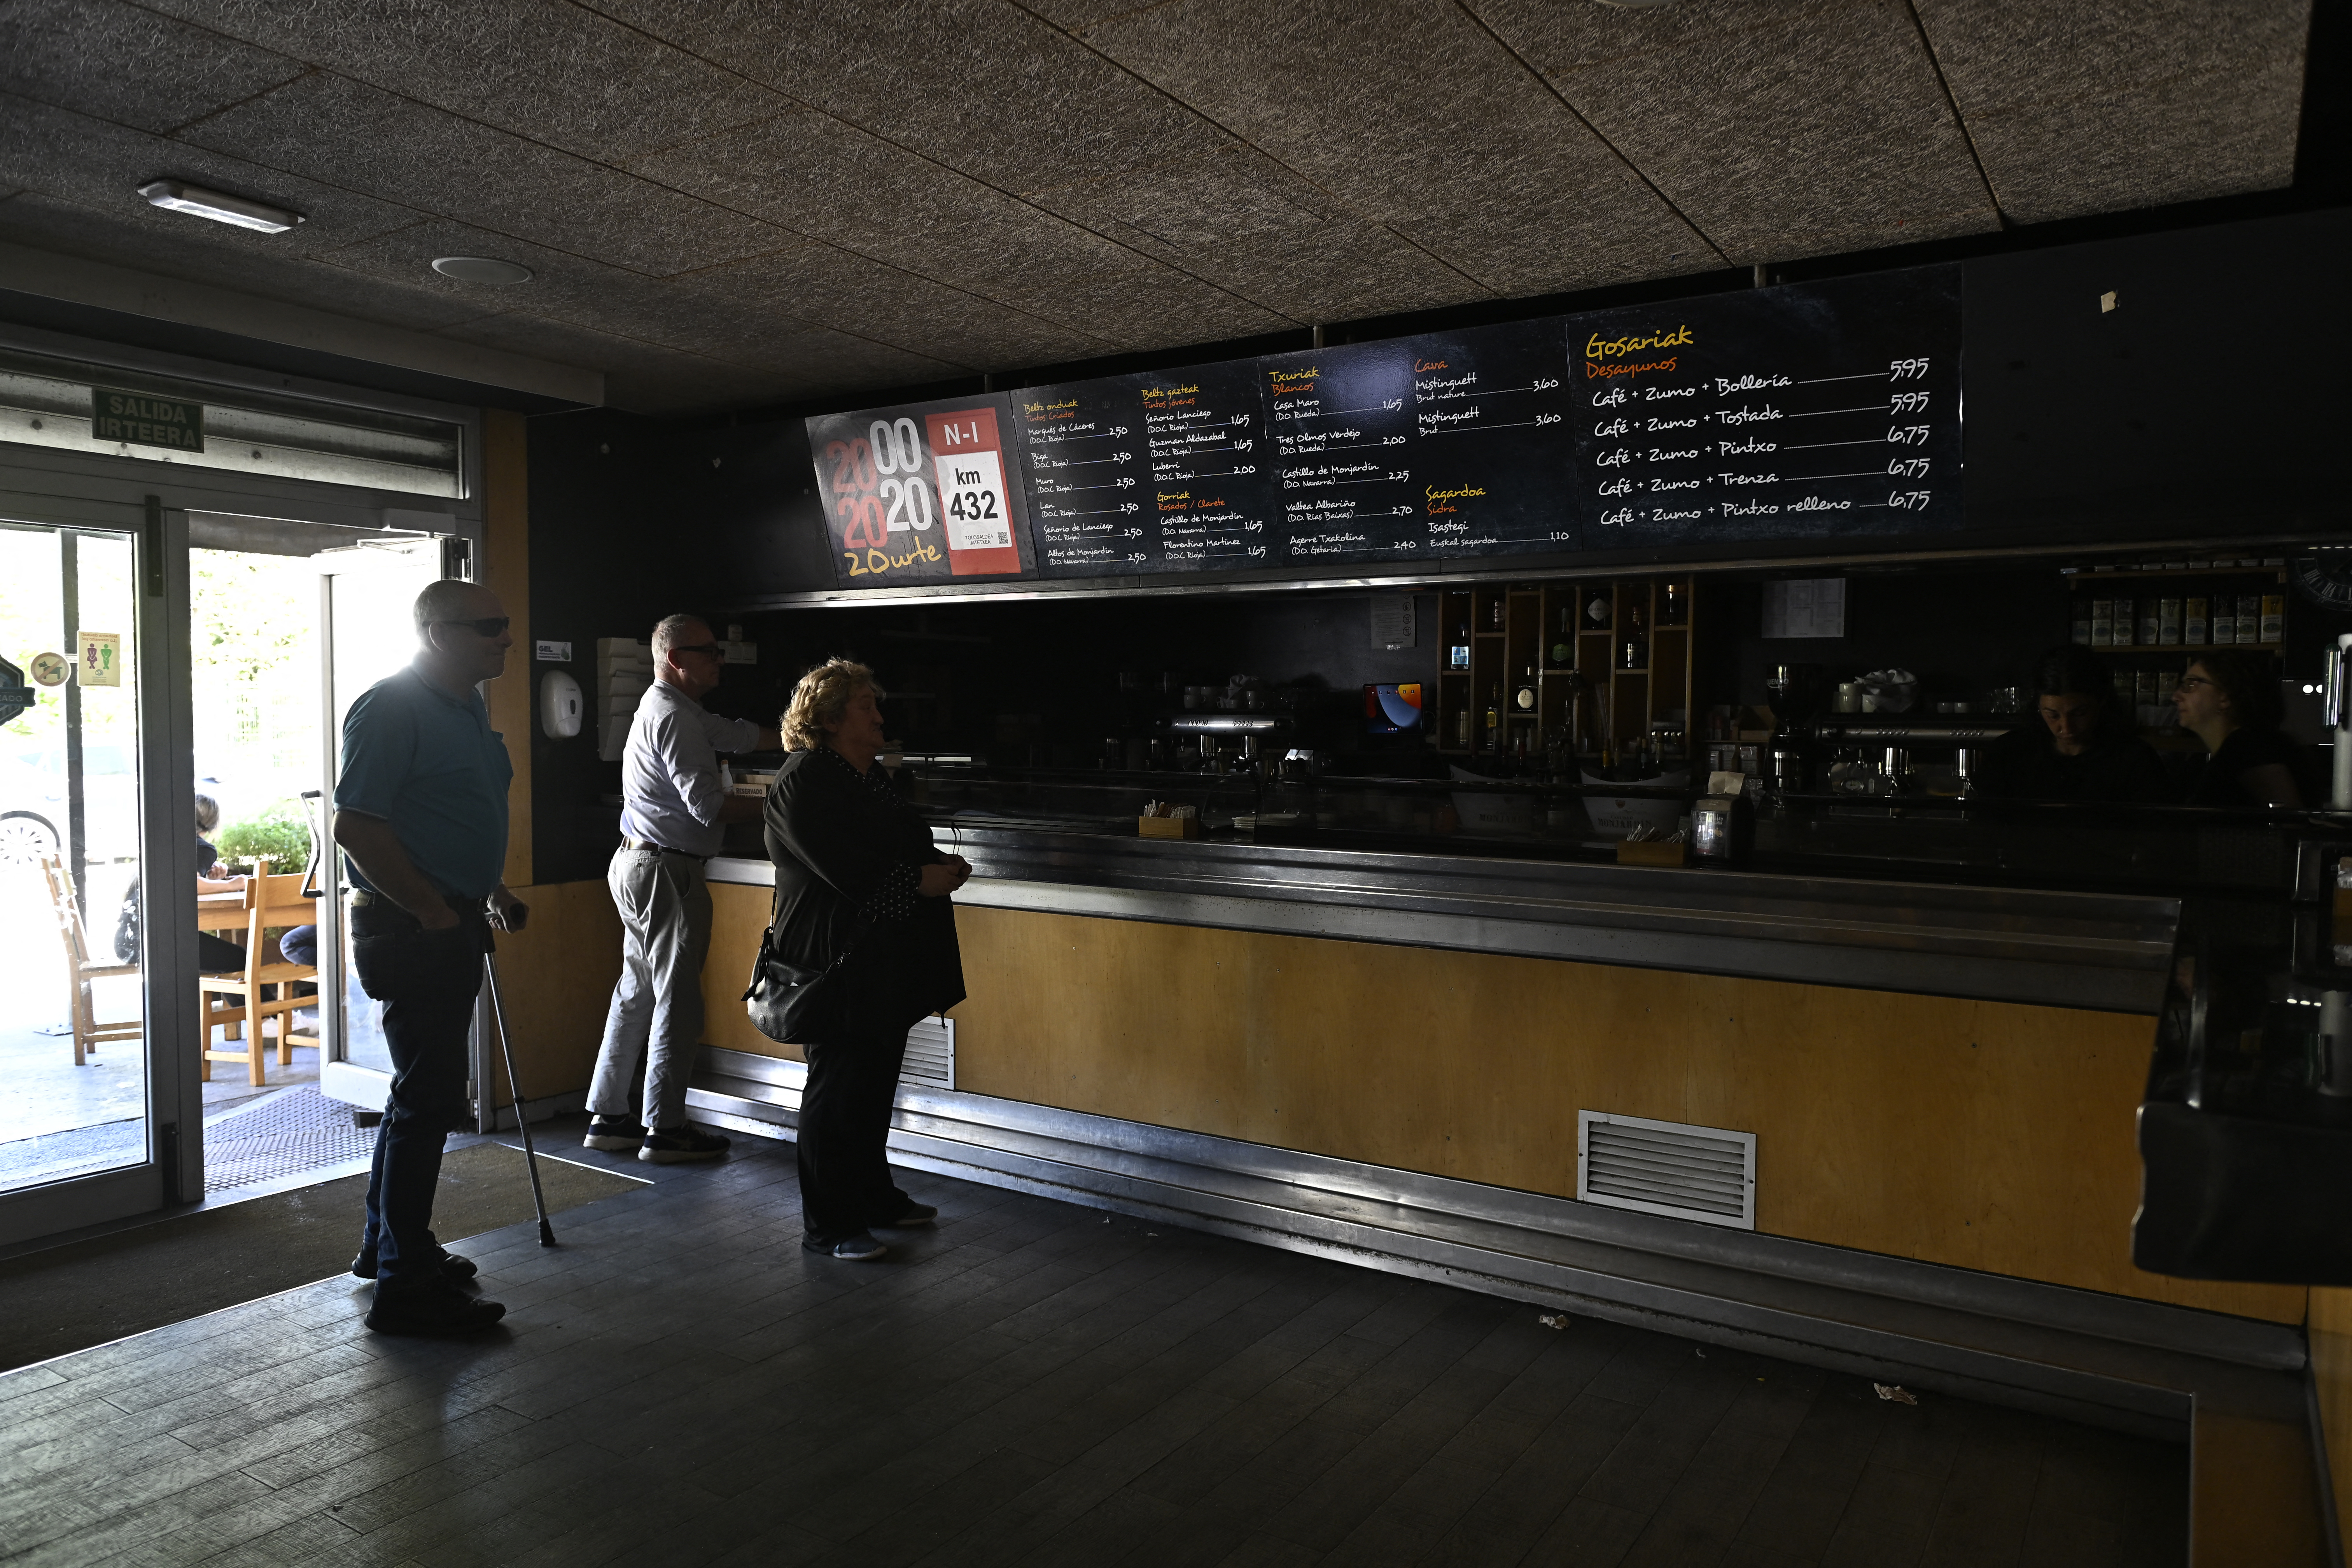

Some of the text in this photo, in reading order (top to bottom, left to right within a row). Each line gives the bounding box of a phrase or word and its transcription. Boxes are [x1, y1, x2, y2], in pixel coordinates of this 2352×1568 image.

[1586, 325, 1693, 360] Gosariak
[1415, 359, 1448, 372] Cava
[1586, 357, 1677, 379] Desayunos
[1269, 366, 1320, 382] Txuriak
[1416, 372, 1477, 390] Mistinguett
[1271, 382, 1314, 396] Blancos
[1416, 378, 1559, 403] Brut nature 3,60
[1592, 358, 1930, 408] Café Zumo Bollería 5,95
[1141, 383, 1199, 401] Beltz gazteak
[109, 395, 187, 424] SALIDA
[1023, 399, 1078, 414] Beltz onduak
[1143, 397, 1195, 409] Tintos jóvenes
[1274, 399, 1319, 410] Casa Maro
[1276, 399, 1402, 421] (D.O. Rueda) 1,65
[1049, 410, 1074, 420] Criados
[1146, 410, 1211, 424] Señorio Lanciego
[1419, 406, 1480, 424] Mistinguett
[1594, 392, 1930, 438] Café Zumo Tostada 5,95
[1028, 426, 1055, 436] Marqués
[1069, 423, 1095, 431] Cáceres
[1169, 422, 1188, 432] Rioja)
[1231, 414, 1249, 427] 1,65
[1419, 413, 1561, 436] Brut 3,60
[100, 416, 196, 447] IRTEERA
[1049, 434, 1065, 443] Rioja)
[1109, 427, 1127, 438] 2,50
[1276, 428, 1360, 444] Tres Olmos Verdejo
[1149, 431, 1227, 448] Guzman Aldazabal
[1280, 436, 1406, 455] (D.O. Rueda) 2,00
[1597, 425, 1930, 468] Café Zumo Pintxo 6,75
[1172, 446, 1192, 457] Rioja)
[1234, 439, 1252, 452] 1,65
[1031, 453, 1048, 462] Biga
[1053, 459, 1069, 468] Rioja)
[1113, 452, 1131, 464] 2,50
[1153, 462, 1180, 471] Luberri
[1176, 471, 1195, 480] Rioja)
[1234, 466, 1255, 475] 2,00
[1283, 461, 1379, 478] Castillo de Monjardín
[955, 468, 981, 486] km
[1284, 470, 1409, 489] (D.O. Navarra) 2,25
[1598, 458, 1931, 497] Café Zumo Trenza 6,75
[1057, 484, 1072, 493] Rioja)
[1116, 478, 1135, 490] 2,50
[1426, 483, 1486, 503] Sagardoa
[1157, 490, 1190, 502] Gorriak
[950, 490, 998, 521] 432
[1060, 509, 1076, 517] Rioja)
[1120, 503, 1139, 514] 2,50
[1157, 497, 1225, 511] Rosados / Clarete
[1286, 500, 1356, 511] Valtea Albariño
[1427, 502, 1457, 516] Sidra
[1600, 490, 1931, 527] Café Zumo Pintxo relleno 6,75
[1161, 511, 1243, 525] Castillo de Monjardín
[1288, 506, 1413, 522] (D.O. Rías Baixas) 2,70
[1044, 525, 1069, 534] Señorio
[1083, 523, 1113, 532] Lanciego
[1179, 525, 1206, 534] Navarra)
[1245, 520, 1263, 533] 1,65
[1428, 519, 1469, 534] Isastegi
[1064, 533, 1080, 542] Rioja)
[1124, 528, 1143, 540] 2,50
[1290, 533, 1366, 547] Agerre Txakolina
[1430, 532, 1569, 547] Euskal sagardoa 1,10
[1163, 537, 1241, 549] Florentino Martinez
[1292, 541, 1416, 555] (D.O. Getaria) 2,40
[1048, 548, 1064, 558] Altos
[1077, 546, 1114, 557] Monjardín
[1128, 553, 1146, 564] 2,50
[1187, 550, 1206, 560] Rioja)
[1248, 546, 1266, 558] 1,65
